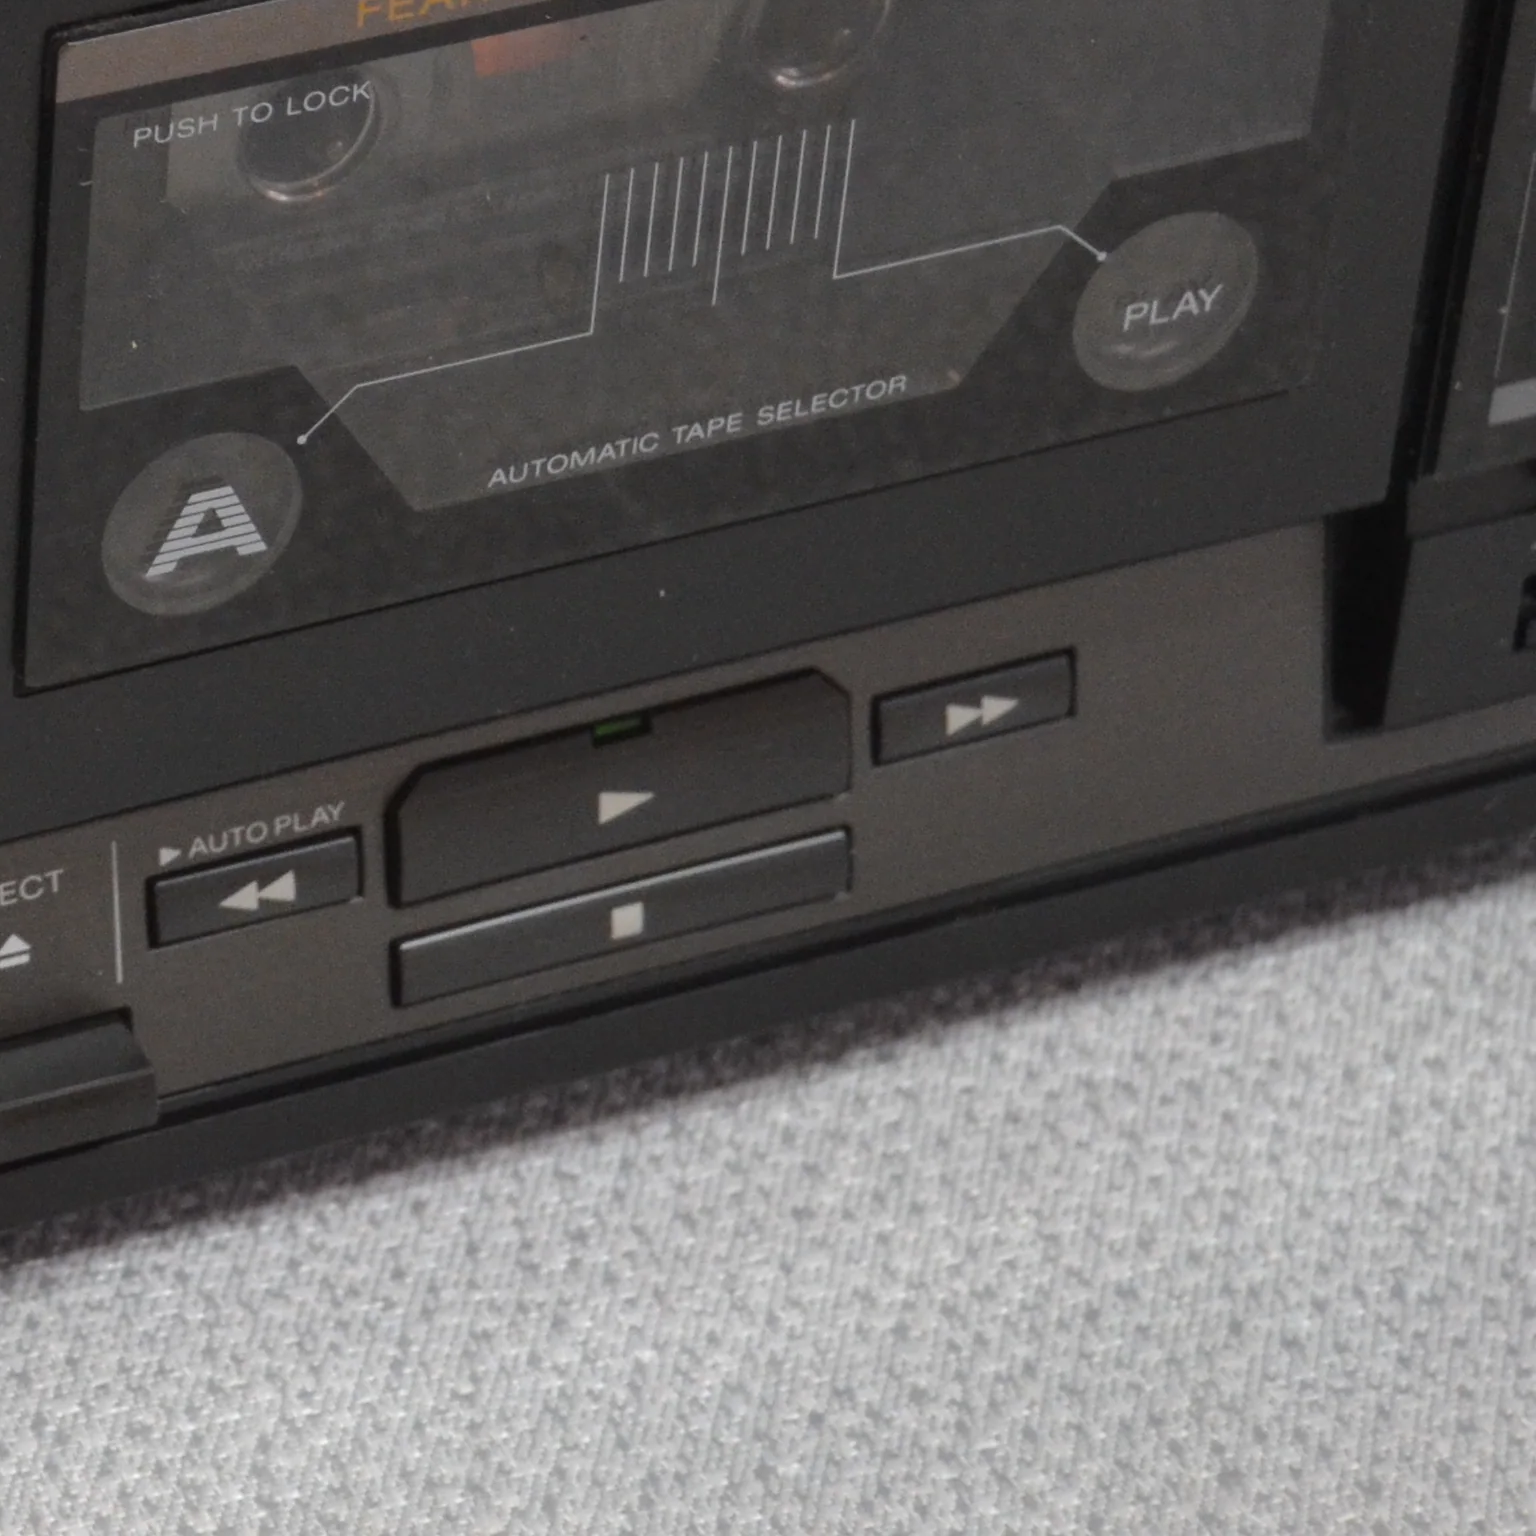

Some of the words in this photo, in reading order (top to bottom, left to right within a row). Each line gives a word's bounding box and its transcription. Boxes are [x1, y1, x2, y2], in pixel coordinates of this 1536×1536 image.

[133, 111, 219, 148] PUSH
[232, 101, 273, 127] TO
[287, 80, 371, 117] LOCK
[1123, 283, 1223, 332] PLAY
[487, 431, 660, 488] AUTOMATIC
[672, 411, 742, 447] TAPE
[756, 374, 908, 427] SELECTOR
[145, 485, 268, 579] A
[188, 820, 268, 860] AUTO
[276, 801, 346, 837] PLAY
